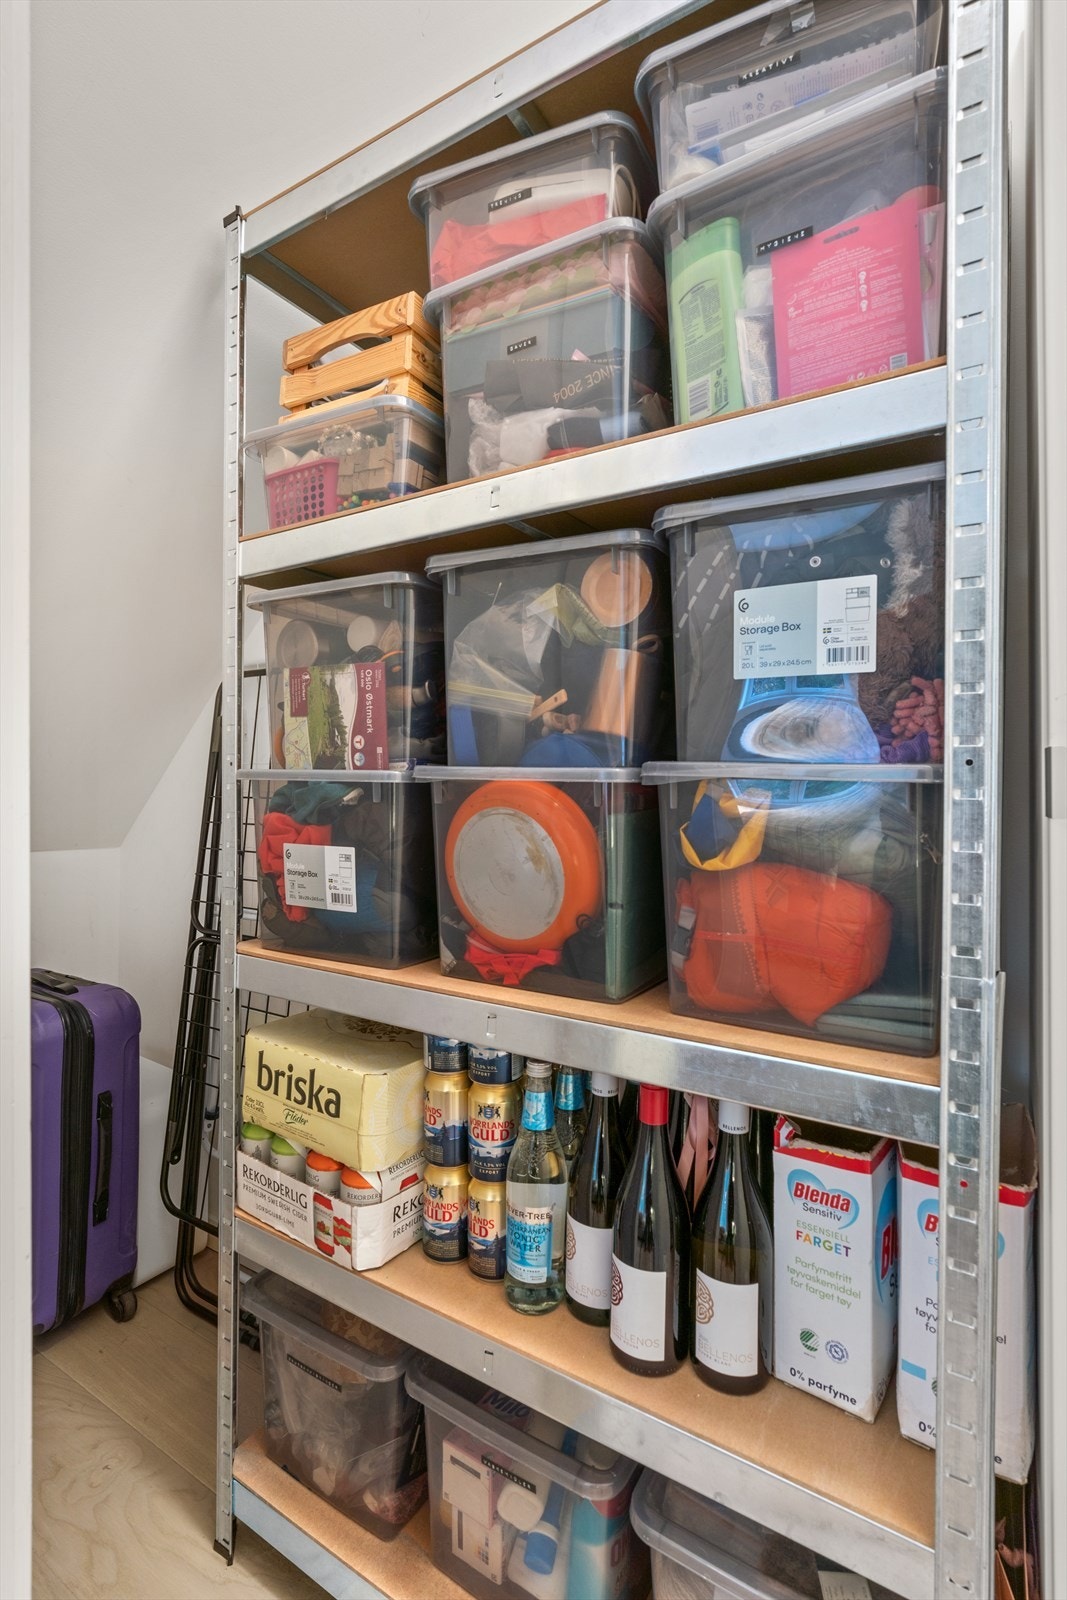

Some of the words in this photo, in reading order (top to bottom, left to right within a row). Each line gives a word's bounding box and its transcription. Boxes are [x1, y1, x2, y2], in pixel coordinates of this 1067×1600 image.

[742, 55, 794, 80] KREATIVT
[759, 230, 805, 252] HYGIENE
[585, 365, 616, 389] INCE
[553, 379, 583, 403] 2004
[739, 614, 776, 626] Module
[739, 624, 780, 636] Storage
[781, 621, 802, 632] Box
[365, 669, 373, 691] Oslo
[365, 693, 374, 734] Østmark
[286, 868, 307, 878] Storage
[307, 870, 318, 878] Box
[257, 1049, 341, 1119] briska
[424, 1113, 437, 1126] LD
[469, 1116, 515, 1130] NORRLANDS
[472, 1126, 510, 1142] GULD
[242, 1163, 308, 1209] REKORDERLIG
[793, 1181, 852, 1213] Blenda
[242, 1183, 267, 1201] PREMIUM
[267, 1196, 291, 1213] SWEDISH
[292, 1208, 308, 1223] CIDER
[802, 1202, 842, 1222] Sensitiv
[510, 1230, 539, 1244] TONIC
[795, 1230, 852, 1257] FARGET
[796, 1219, 851, 1244] ESSENSIELL
[510, 1238, 542, 1252] WATER
[786, 1265, 861, 1299] tøyvaskemiddel
[794, 1256, 852, 1284] Parfymefritt
[790, 1277, 804, 1288] for
[805, 1284, 835, 1300] farget
[837, 1295, 852, 1309] tøy
[698, 1338, 753, 1364] BELLENOS
[789, 1367, 805, 1382] 0%
[808, 1377, 858, 1406] parfyme
